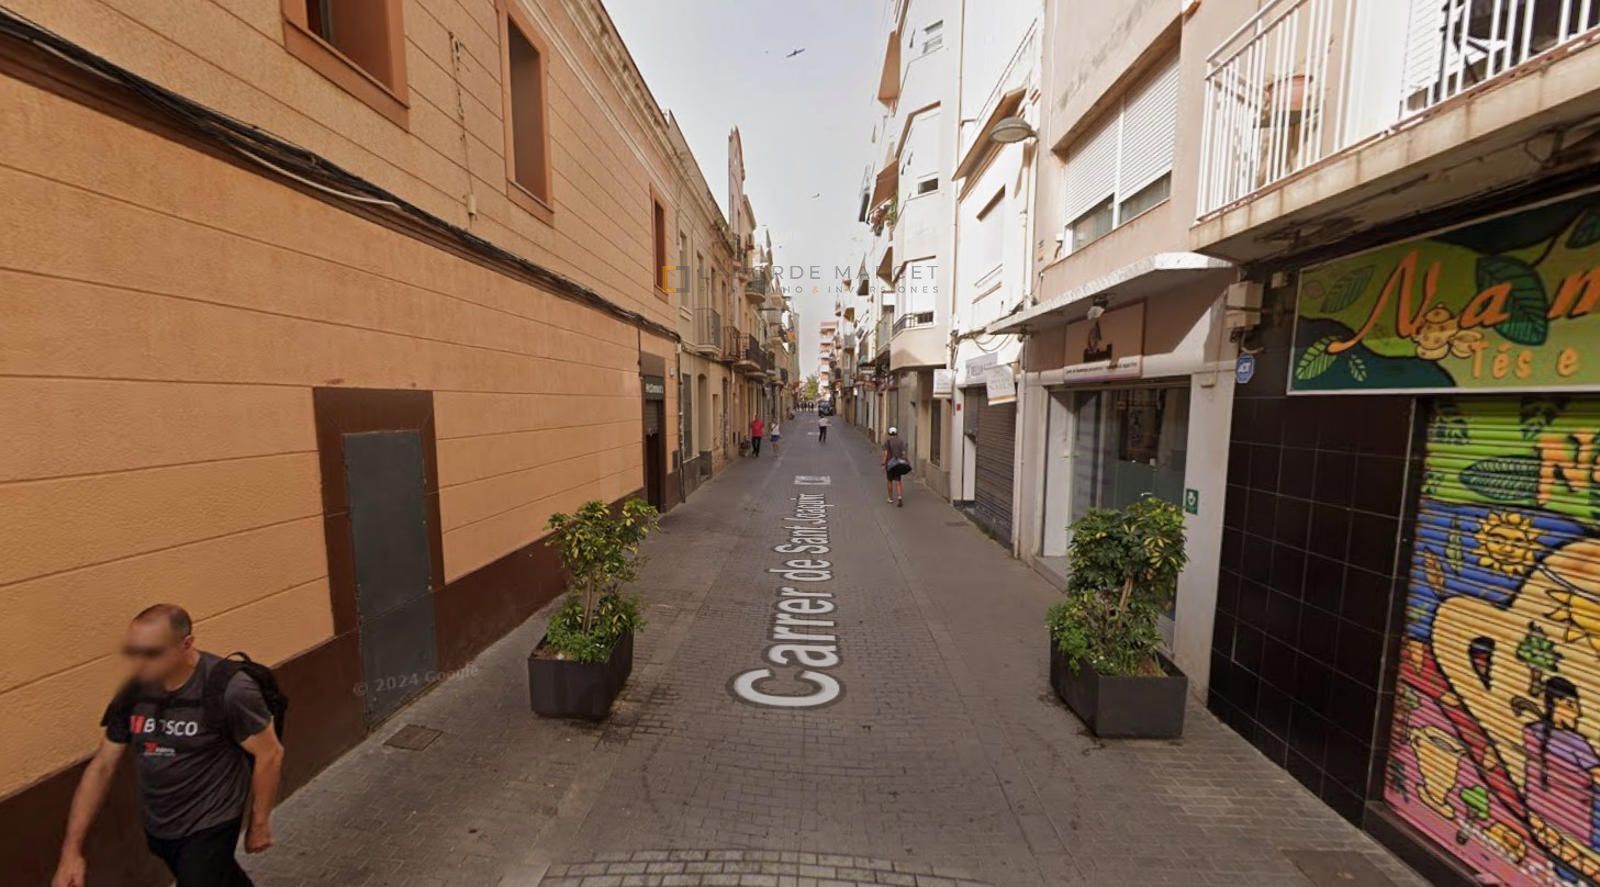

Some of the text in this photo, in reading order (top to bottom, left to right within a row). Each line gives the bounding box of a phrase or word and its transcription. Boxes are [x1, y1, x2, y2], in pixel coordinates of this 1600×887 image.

[1471, 341, 1579, 379] Tés e
[143, 718, 198, 736] BSCO
